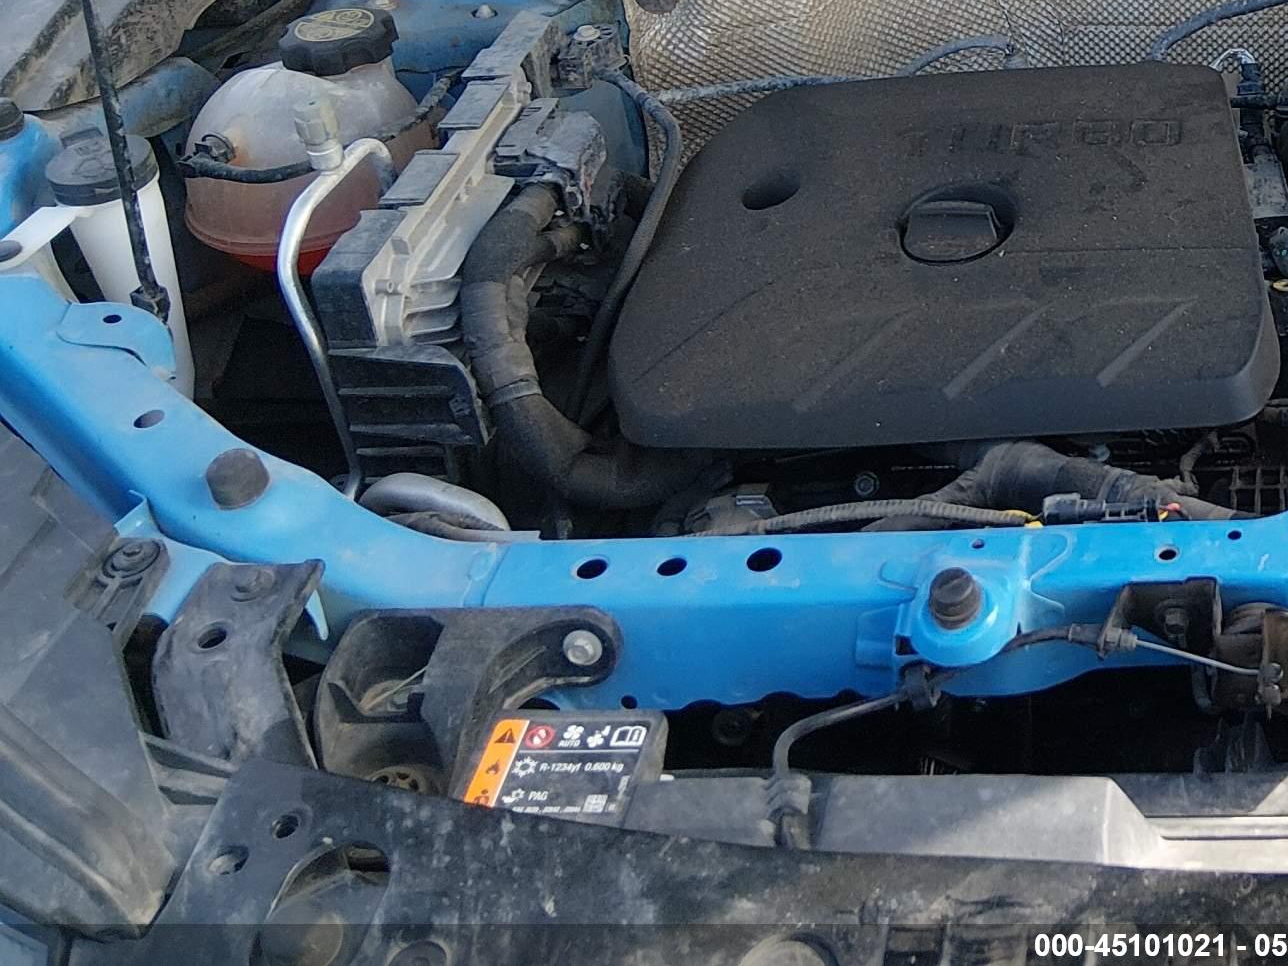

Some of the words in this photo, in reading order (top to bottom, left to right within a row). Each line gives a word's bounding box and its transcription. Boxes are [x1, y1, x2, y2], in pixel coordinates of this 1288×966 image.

[539, 762, 581, 774] R-1234yf
[611, 762, 624, 774] kg
[528, 791, 549, 801] PAG
